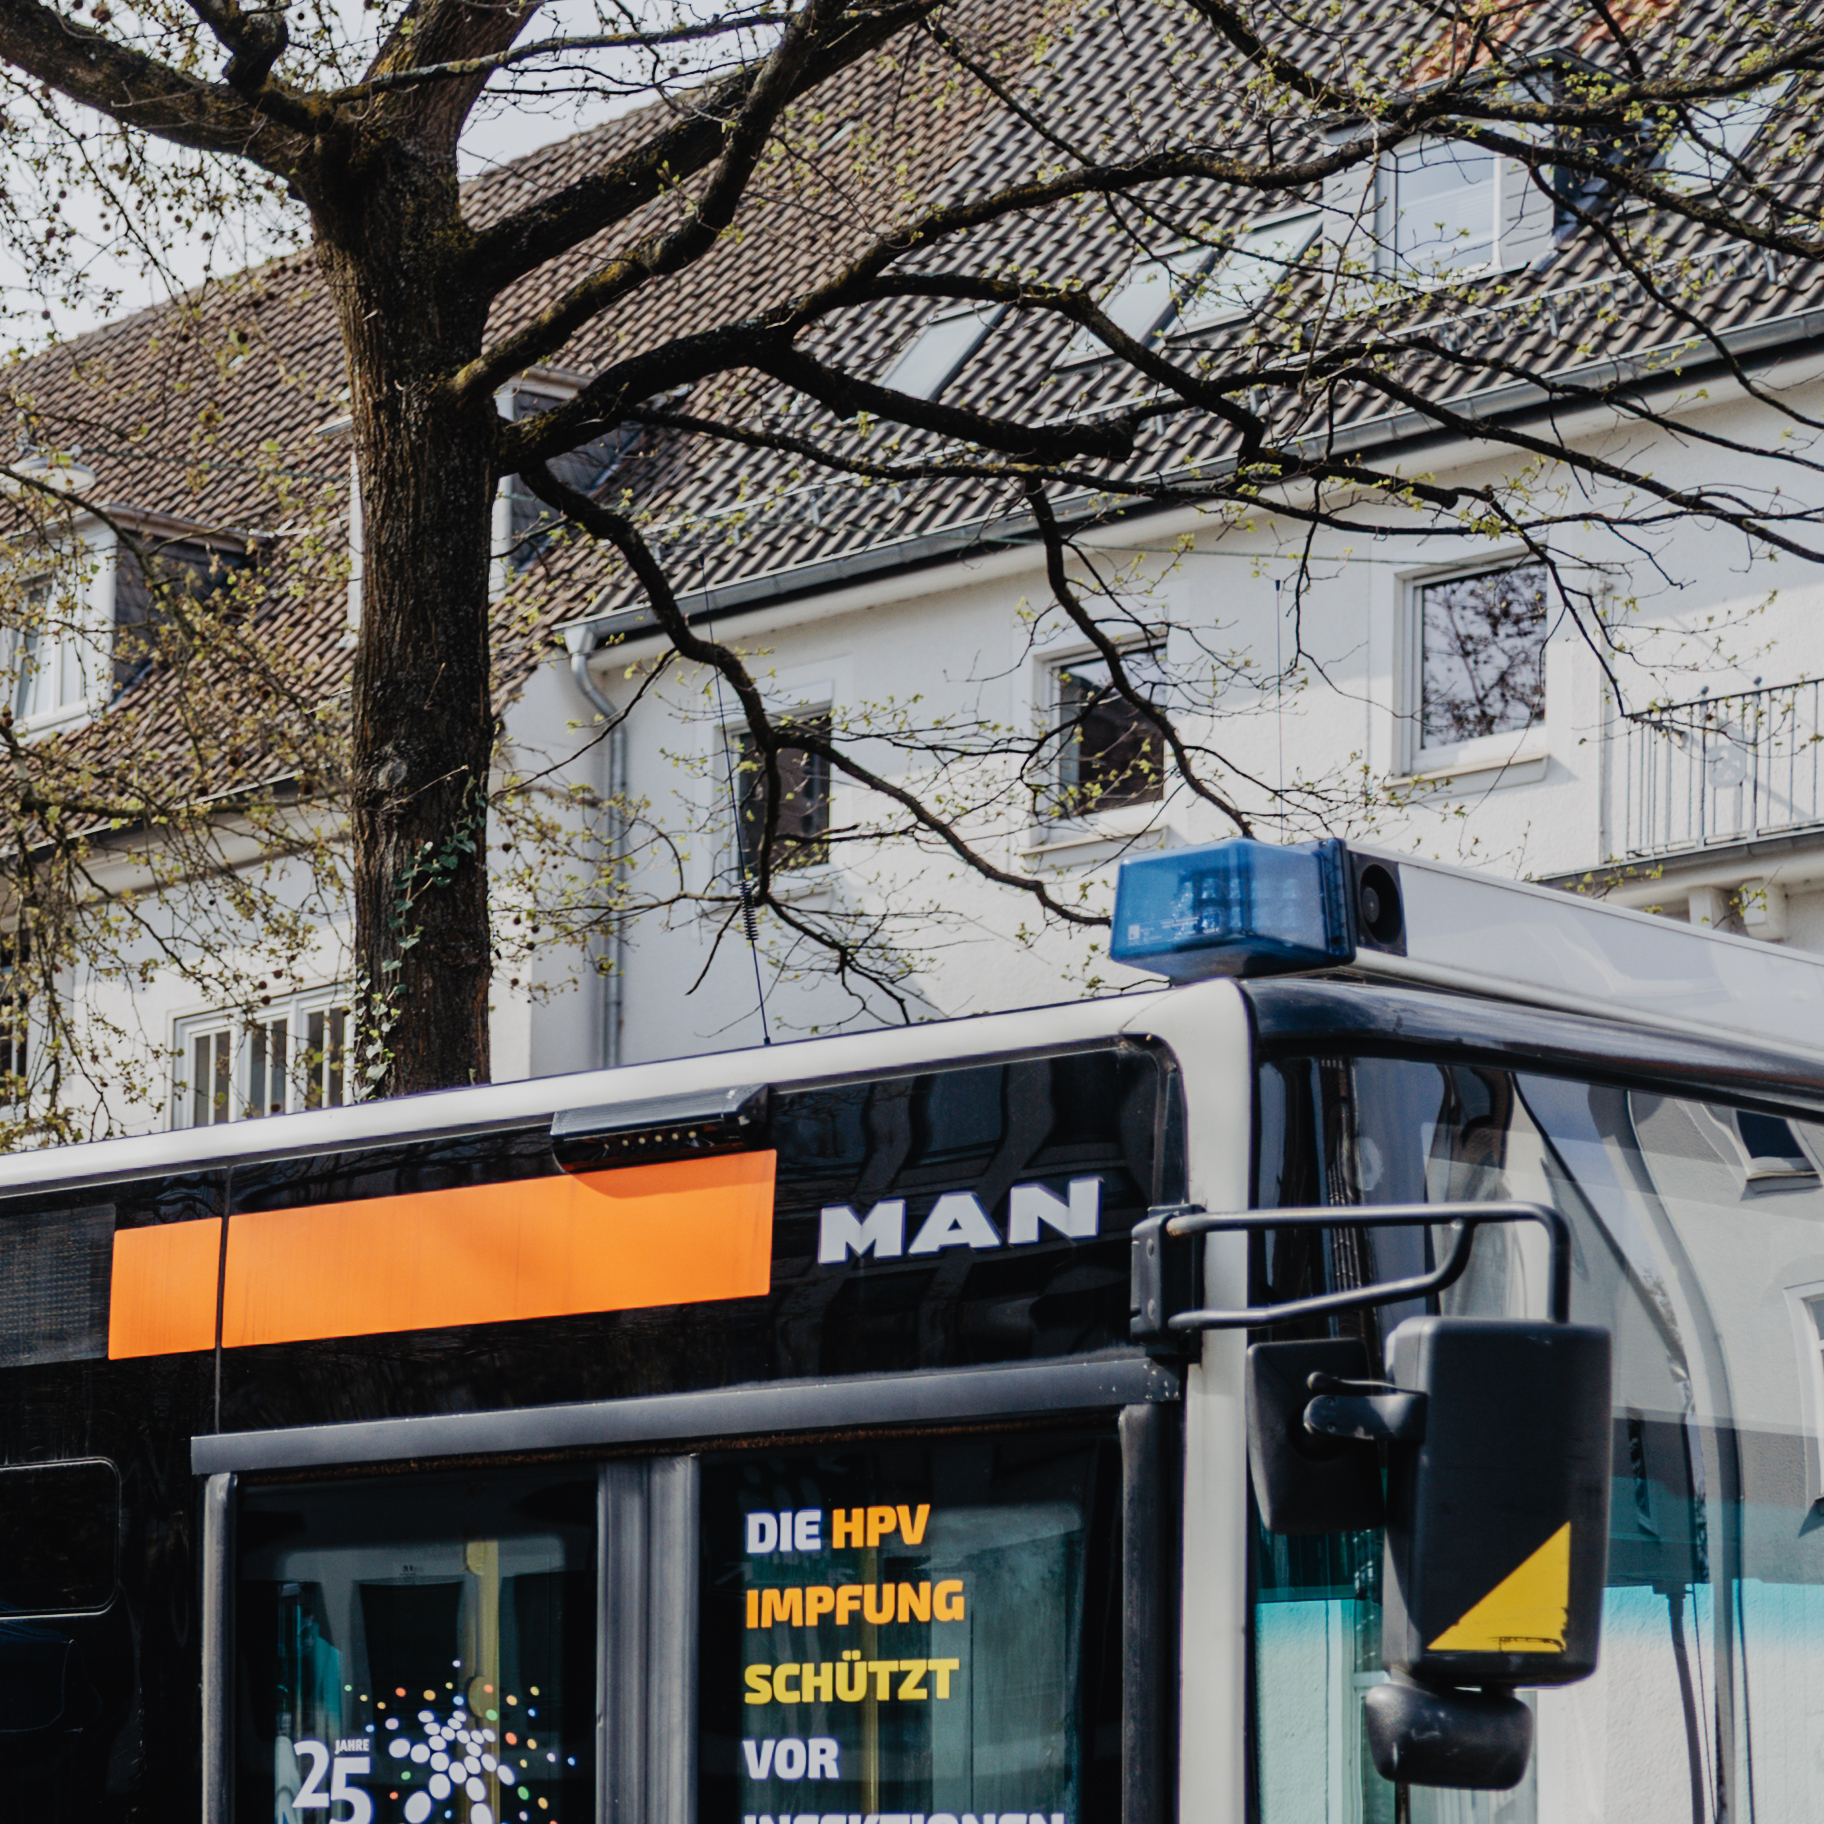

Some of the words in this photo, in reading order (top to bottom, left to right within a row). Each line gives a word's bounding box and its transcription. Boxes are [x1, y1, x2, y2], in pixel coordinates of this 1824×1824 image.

[817, 1176, 1104, 1265] MAN
[745, 1509, 822, 1554] DIE
[831, 1503, 930, 1548] HPV
[745, 1578, 965, 1629] IMPFUNG
[743, 1649, 960, 1705] SCHÜTZT
[334, 1738, 370, 1754] JAHRE
[742, 1737, 839, 1780] VOR
